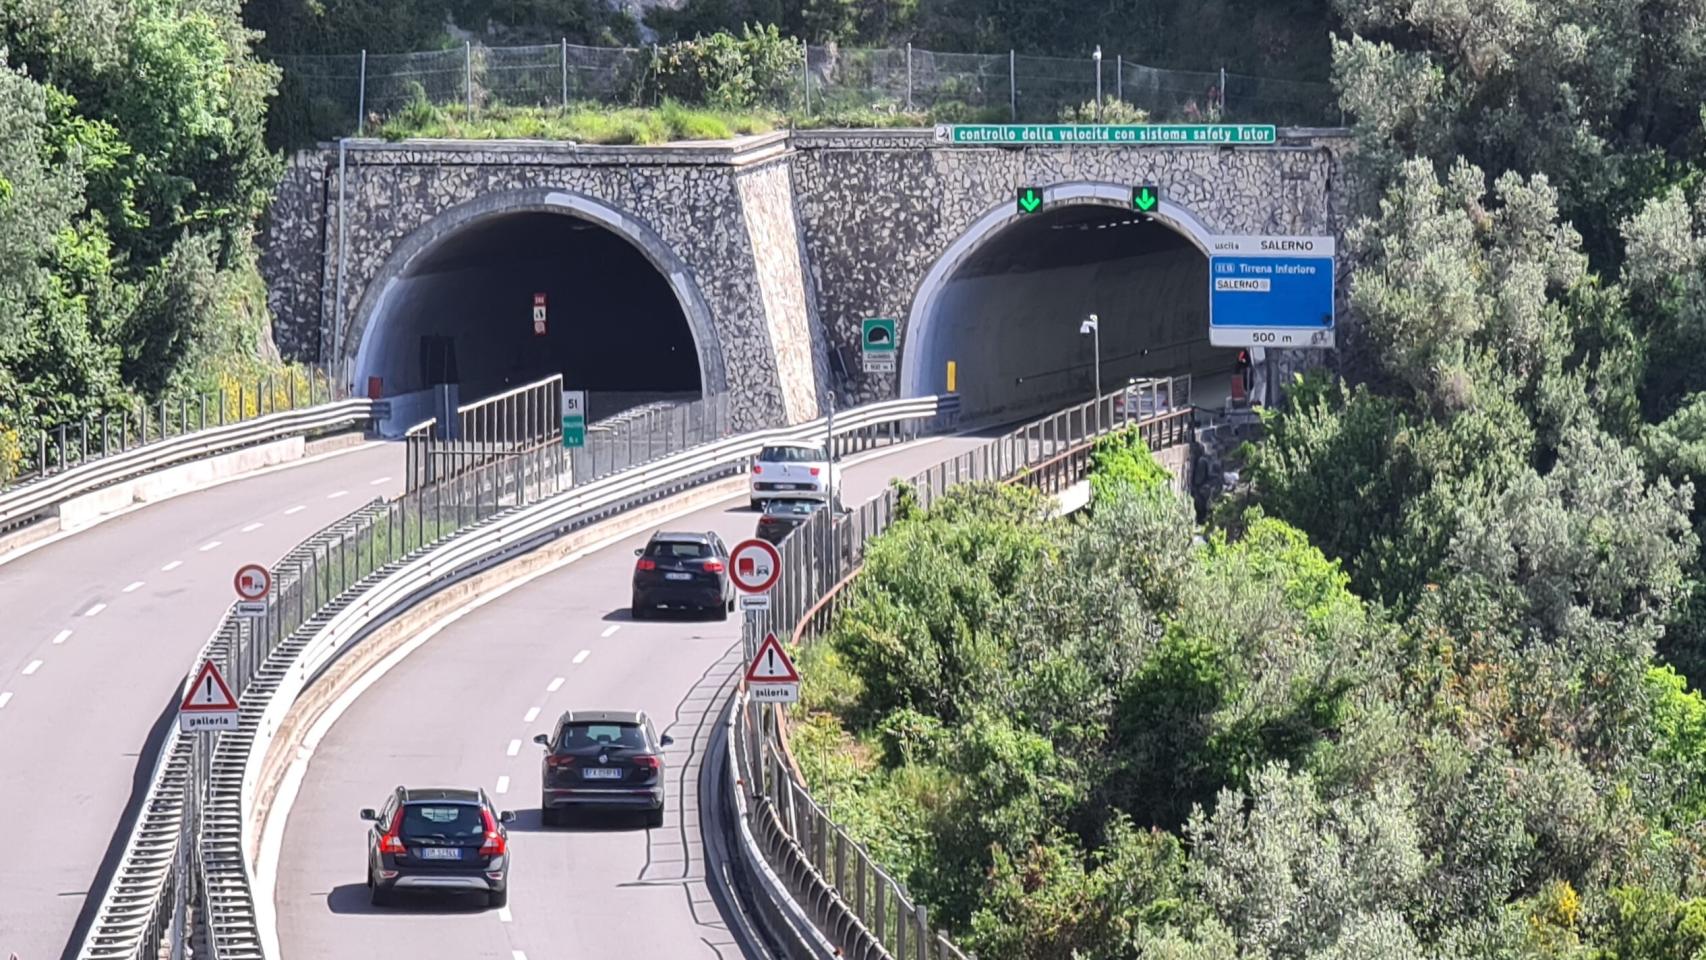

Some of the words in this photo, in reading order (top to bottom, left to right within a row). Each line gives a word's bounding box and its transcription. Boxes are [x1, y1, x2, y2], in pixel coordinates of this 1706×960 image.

[959, 127, 1016, 140] controllo
[1022, 127, 1053, 140] della
[1114, 129, 1135, 140] con
[1140, 126, 1187, 140] sistema
[1193, 127, 1231, 142] safety
[1237, 127, 1270, 140] Tutor
[1215, 241, 1239, 250] uscita
[1260, 240, 1313, 251] SALERNO
[1240, 263, 1272, 273] Tirrena
[1275, 264, 1316, 274] Inferiore
[1217, 280, 1259, 289] SALERNO
[1253, 332, 1276, 343] 500
[1282, 335, 1292, 343] m
[568, 398, 578, 409] 51
[755, 688, 789, 698] galleria
[190, 716, 229, 727] galleria
